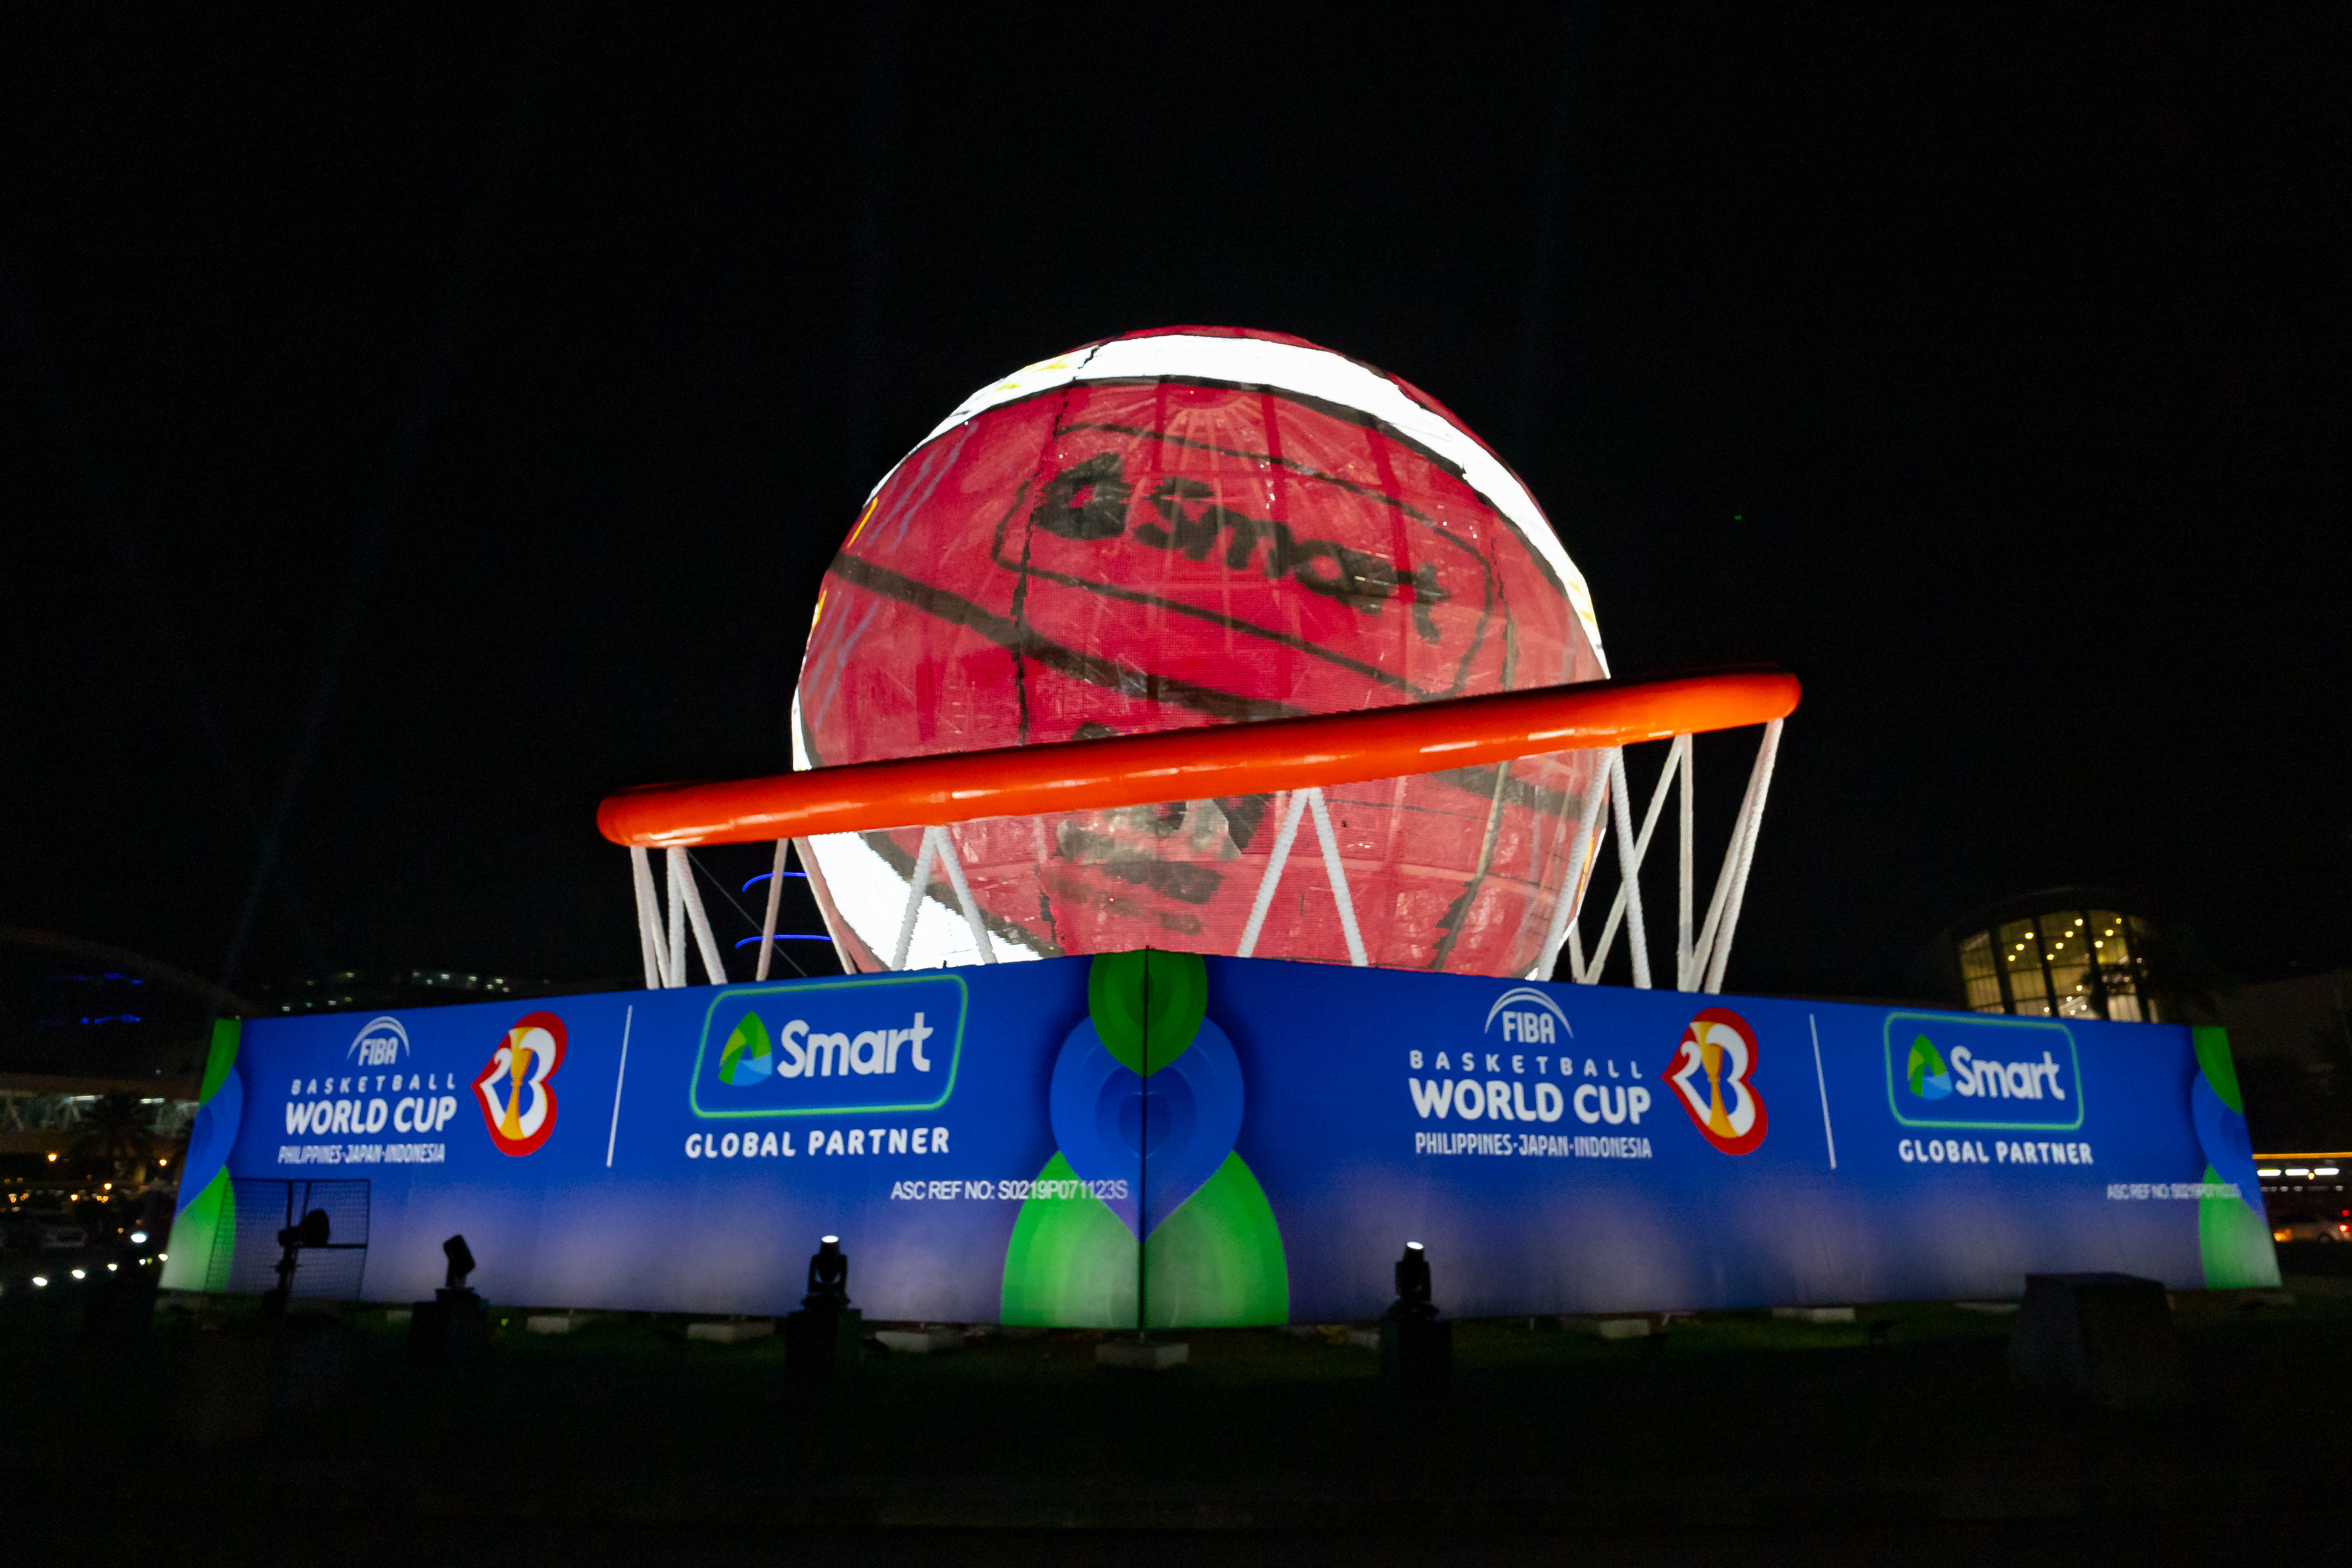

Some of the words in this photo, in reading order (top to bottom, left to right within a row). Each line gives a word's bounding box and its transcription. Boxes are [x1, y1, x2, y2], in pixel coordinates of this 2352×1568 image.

[1502, 1011, 1556, 1044] FIBA
[357, 1036, 397, 1066] FIBA
[777, 1012, 934, 1078] Smart
[1408, 1049, 1643, 1079] BASKETBALL
[1950, 1046, 2066, 1101] Smart
[291, 1073, 456, 1096] BASKETBALL
[286, 1098, 388, 1136] WORLD
[394, 1096, 458, 1134] CUP
[1408, 1078, 1564, 1123] WORLD
[1573, 1084, 1652, 1125] CUP
[684, 1131, 796, 1159] GLOBAL
[808, 1127, 950, 1156] PARTNER
[1898, 1139, 1990, 1163] GLOBAL
[1995, 1140, 2094, 1165] PARTNER
[890, 1181, 926, 1201] ASC
[928, 1181, 963, 1201] REF
[964, 1180, 995, 1200] NO:
